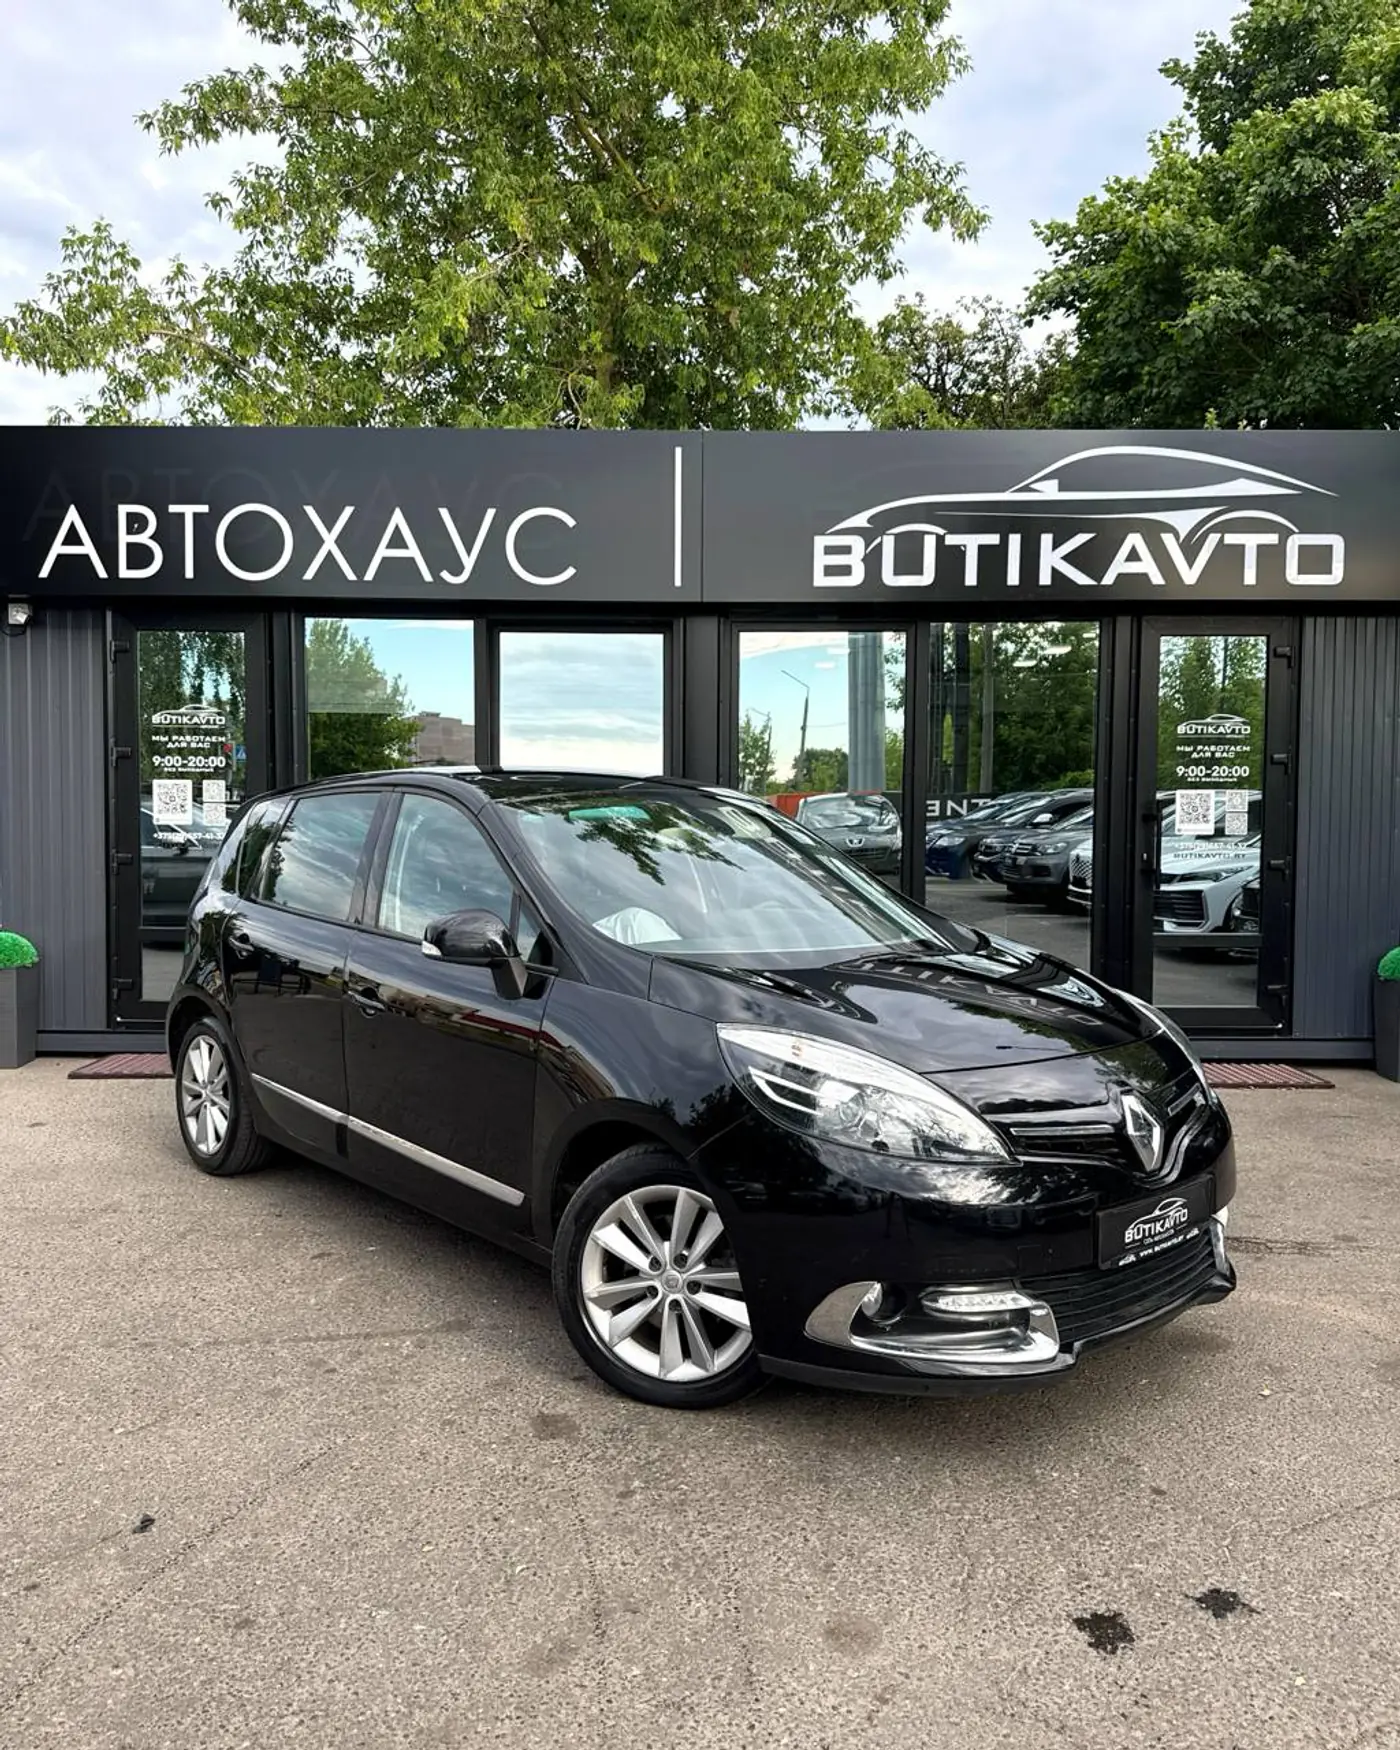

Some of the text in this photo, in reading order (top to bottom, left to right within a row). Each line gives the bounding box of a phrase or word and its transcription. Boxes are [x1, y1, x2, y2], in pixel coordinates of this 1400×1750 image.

[38, 503, 577, 585] АВТОХАУС
[812, 532, 1346, 587] BUTIKAVTO
[151, 715, 226, 725] BUTIKAVTO
[1176, 725, 1251, 734] BUTIKAVTO
[152, 755, 226, 767] 9:00-20:00
[1176, 765, 1250, 777] 9:00-20:00
[1124, 1208, 1188, 1244] BUTIKAVTO
